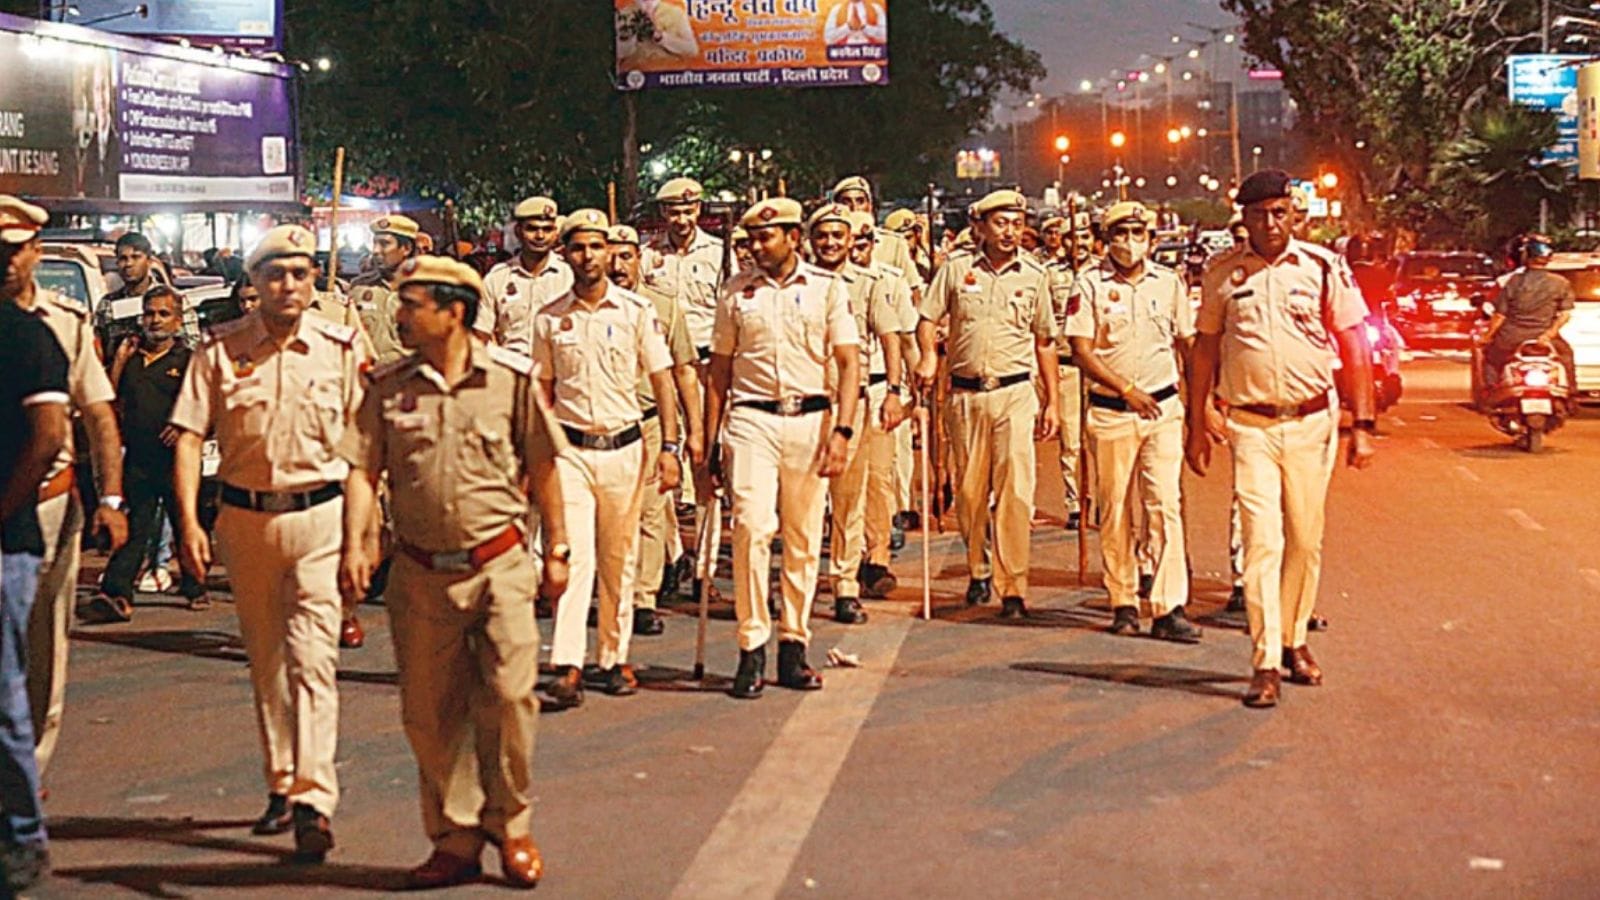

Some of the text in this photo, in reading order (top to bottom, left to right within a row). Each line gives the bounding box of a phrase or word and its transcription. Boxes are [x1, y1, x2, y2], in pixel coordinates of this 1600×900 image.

[706, 47, 748, 63] मन्दिर
[659, 70, 703, 86] भारतीय
[706, 70, 742, 84] जनता
[743, 67, 770, 83] पार्टी
[782, 66, 817, 82] दिल्ली
[820, 65, 850, 80] प्रदेश
